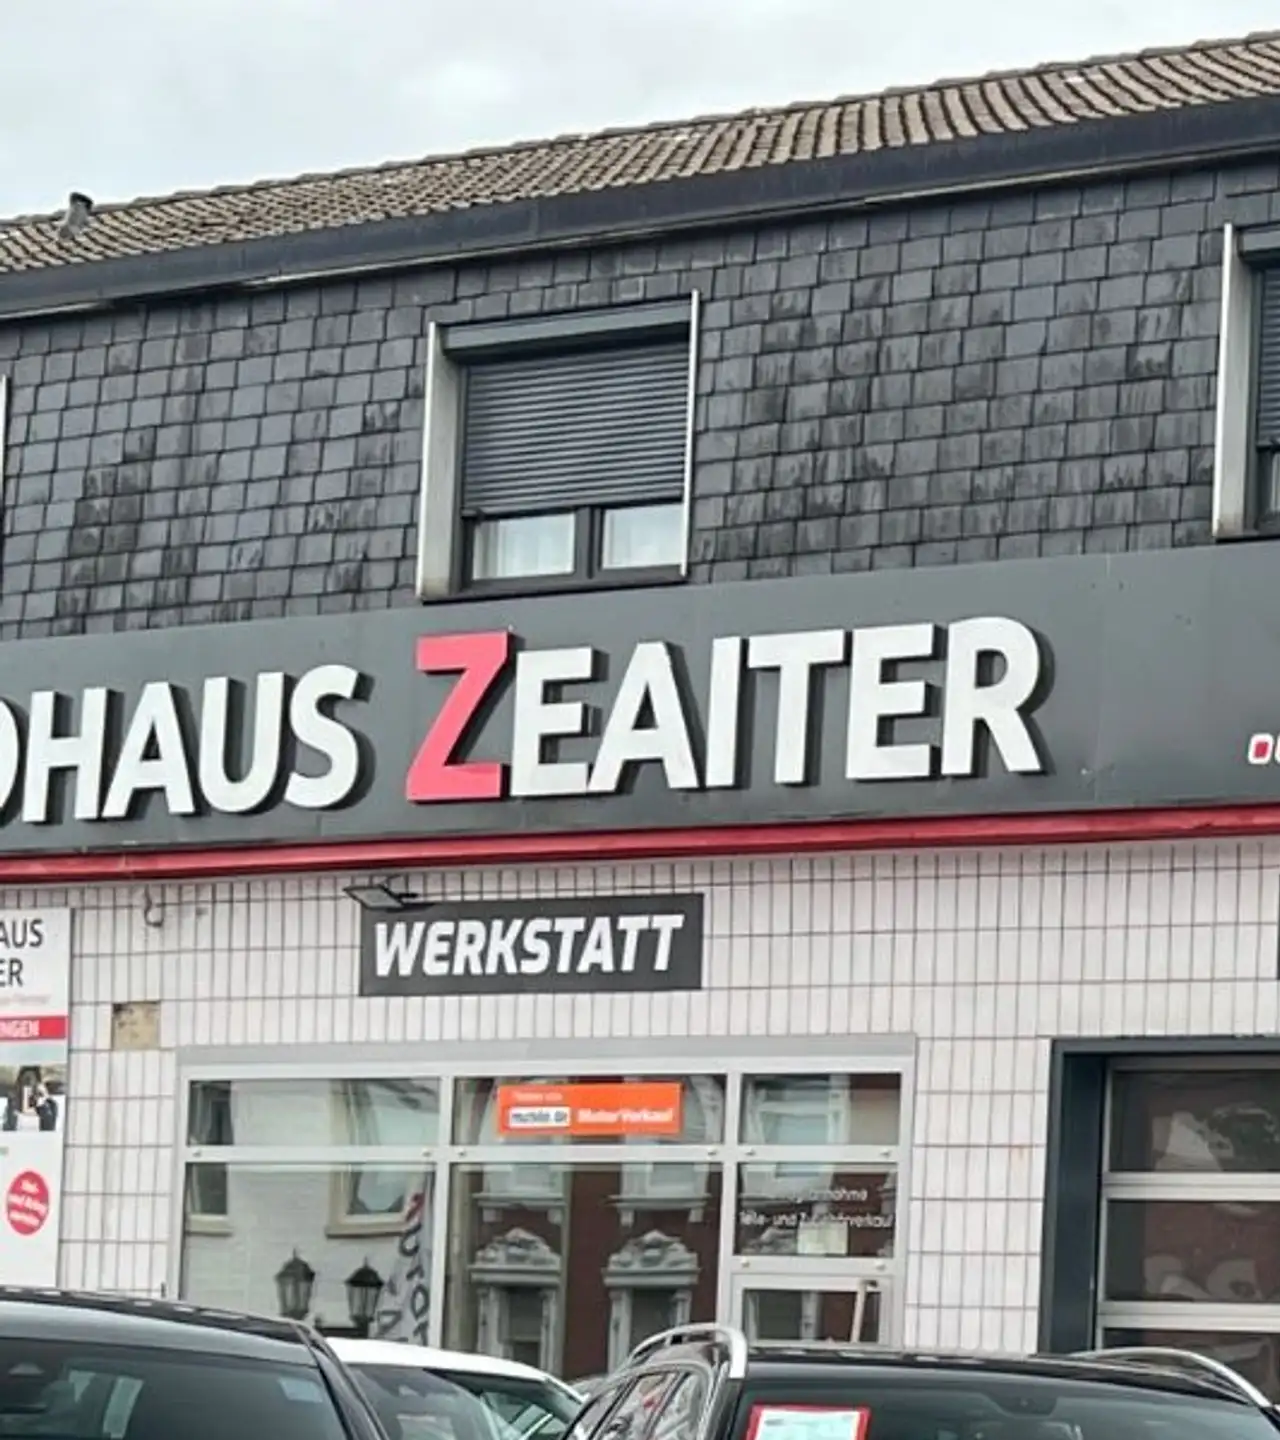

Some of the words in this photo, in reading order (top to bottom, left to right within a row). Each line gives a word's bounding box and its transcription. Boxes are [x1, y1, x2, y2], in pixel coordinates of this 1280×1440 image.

[0, 664, 361, 822] HAUS
[405, 613, 1042, 801] ZEAITER
[375, 914, 685, 977] WERKSTATT
